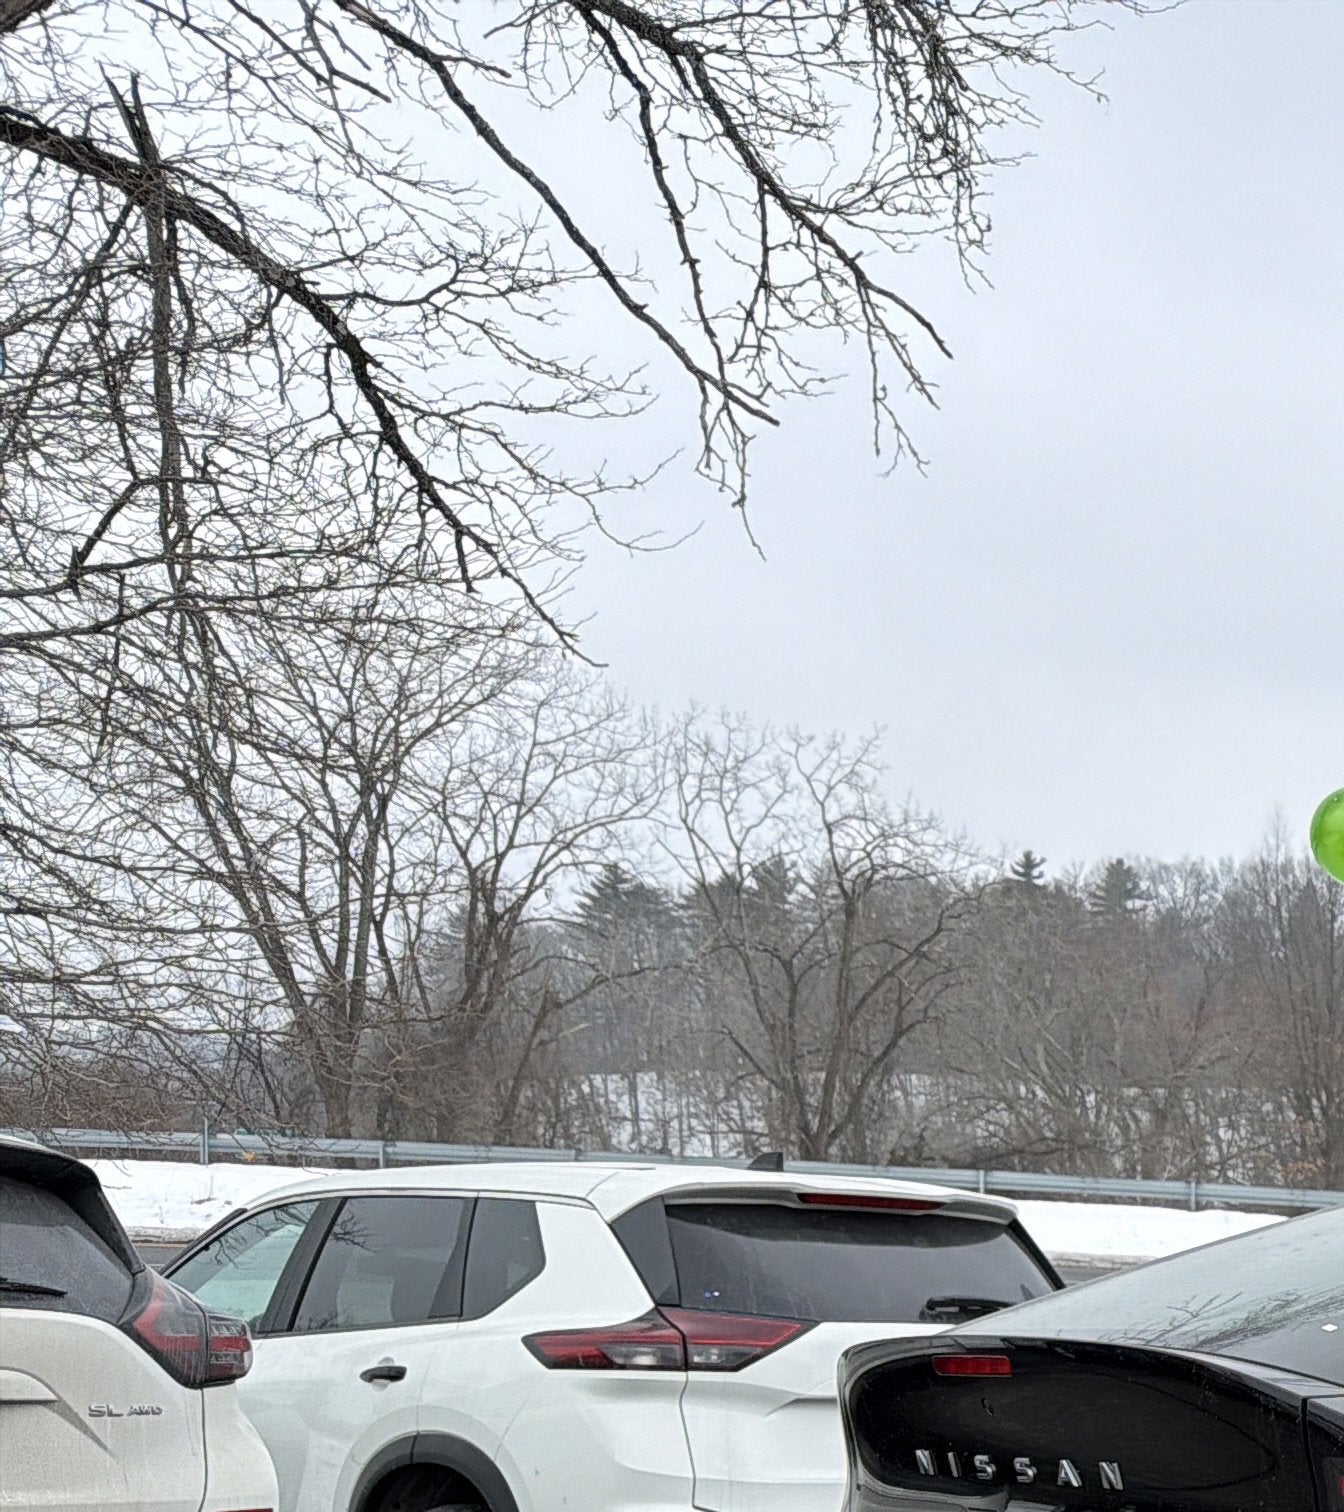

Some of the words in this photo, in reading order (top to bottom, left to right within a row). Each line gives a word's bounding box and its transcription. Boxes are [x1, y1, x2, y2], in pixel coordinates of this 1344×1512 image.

[87, 1404, 124, 1418] SL
[126, 1405, 163, 1417] AWD
[915, 1449, 1125, 1491] NISSAN
